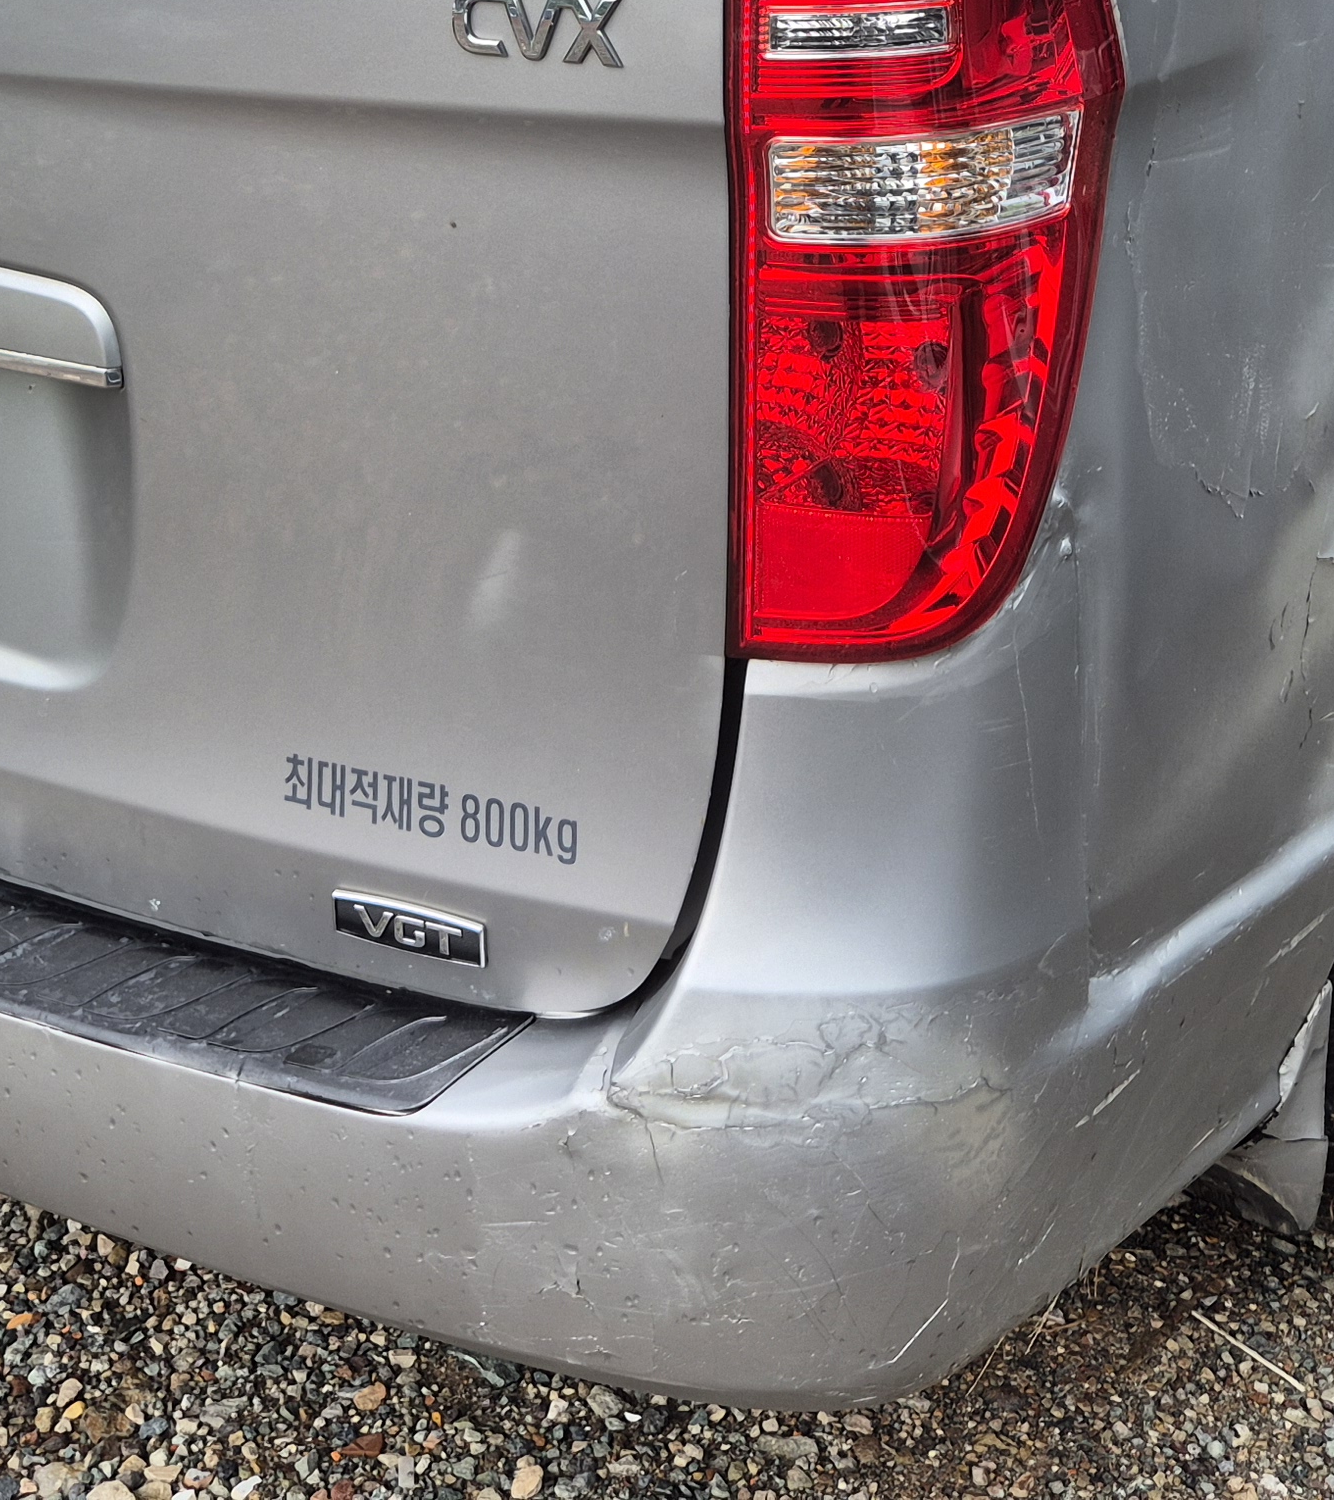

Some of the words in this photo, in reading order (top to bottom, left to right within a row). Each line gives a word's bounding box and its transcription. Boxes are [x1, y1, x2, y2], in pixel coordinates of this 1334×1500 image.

[283, 753, 450, 838] 최대적재량
[460, 793, 578, 865] 800kg
[353, 903, 463, 955] VGT
